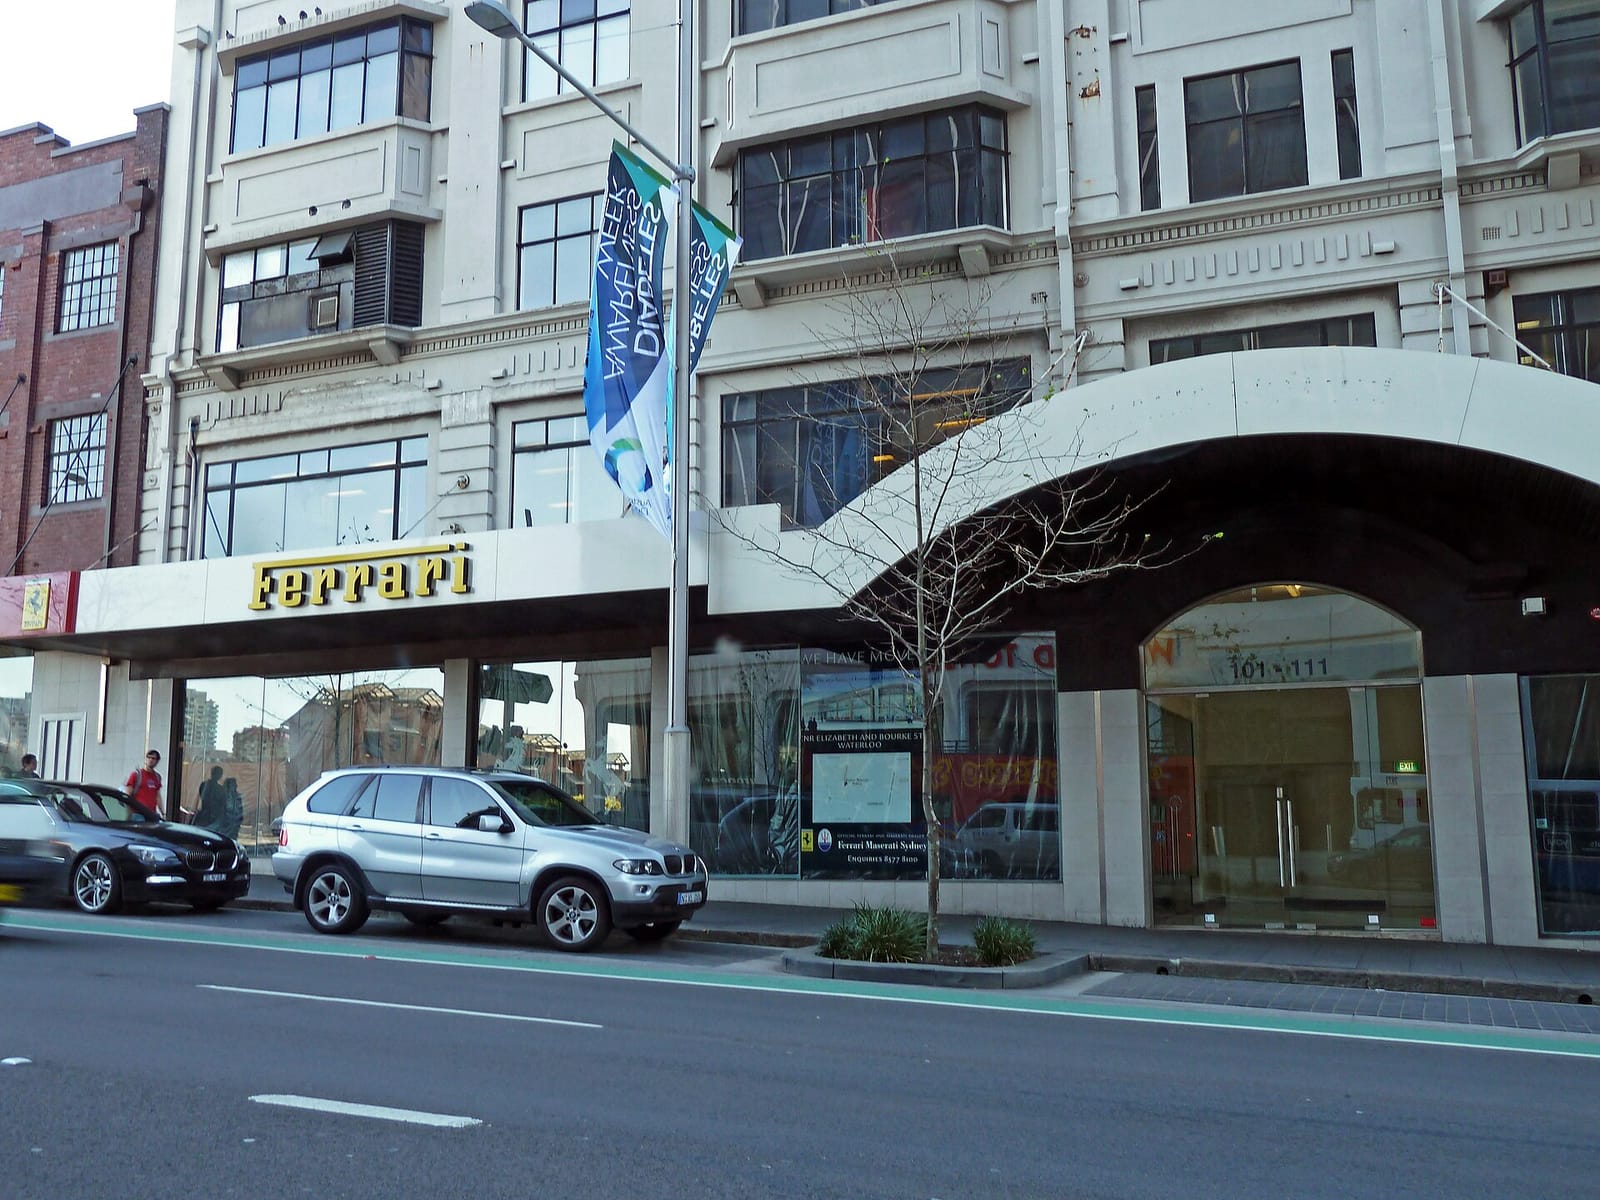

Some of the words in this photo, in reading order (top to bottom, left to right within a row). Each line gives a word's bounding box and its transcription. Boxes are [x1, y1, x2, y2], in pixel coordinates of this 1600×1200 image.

[248, 542, 471, 610] Ferrari
[801, 652, 820, 665] WE
[826, 651, 865, 664] HAVE
[1230, 659, 1264, 679] 101
[1291, 658, 1327, 676] 111
[817, 733, 858, 742] ELIZABETH
[860, 732, 877, 741] AND
[879, 732, 912, 741] BOURKE
[837, 741, 882, 749] WATERLOO
[1399, 762, 1415, 770] EXIT
[838, 840, 864, 849] Ferrari
[865, 840, 899, 850] Maserati
[900, 840, 927, 852] Sydney
[884, 855, 900, 864] 8577
